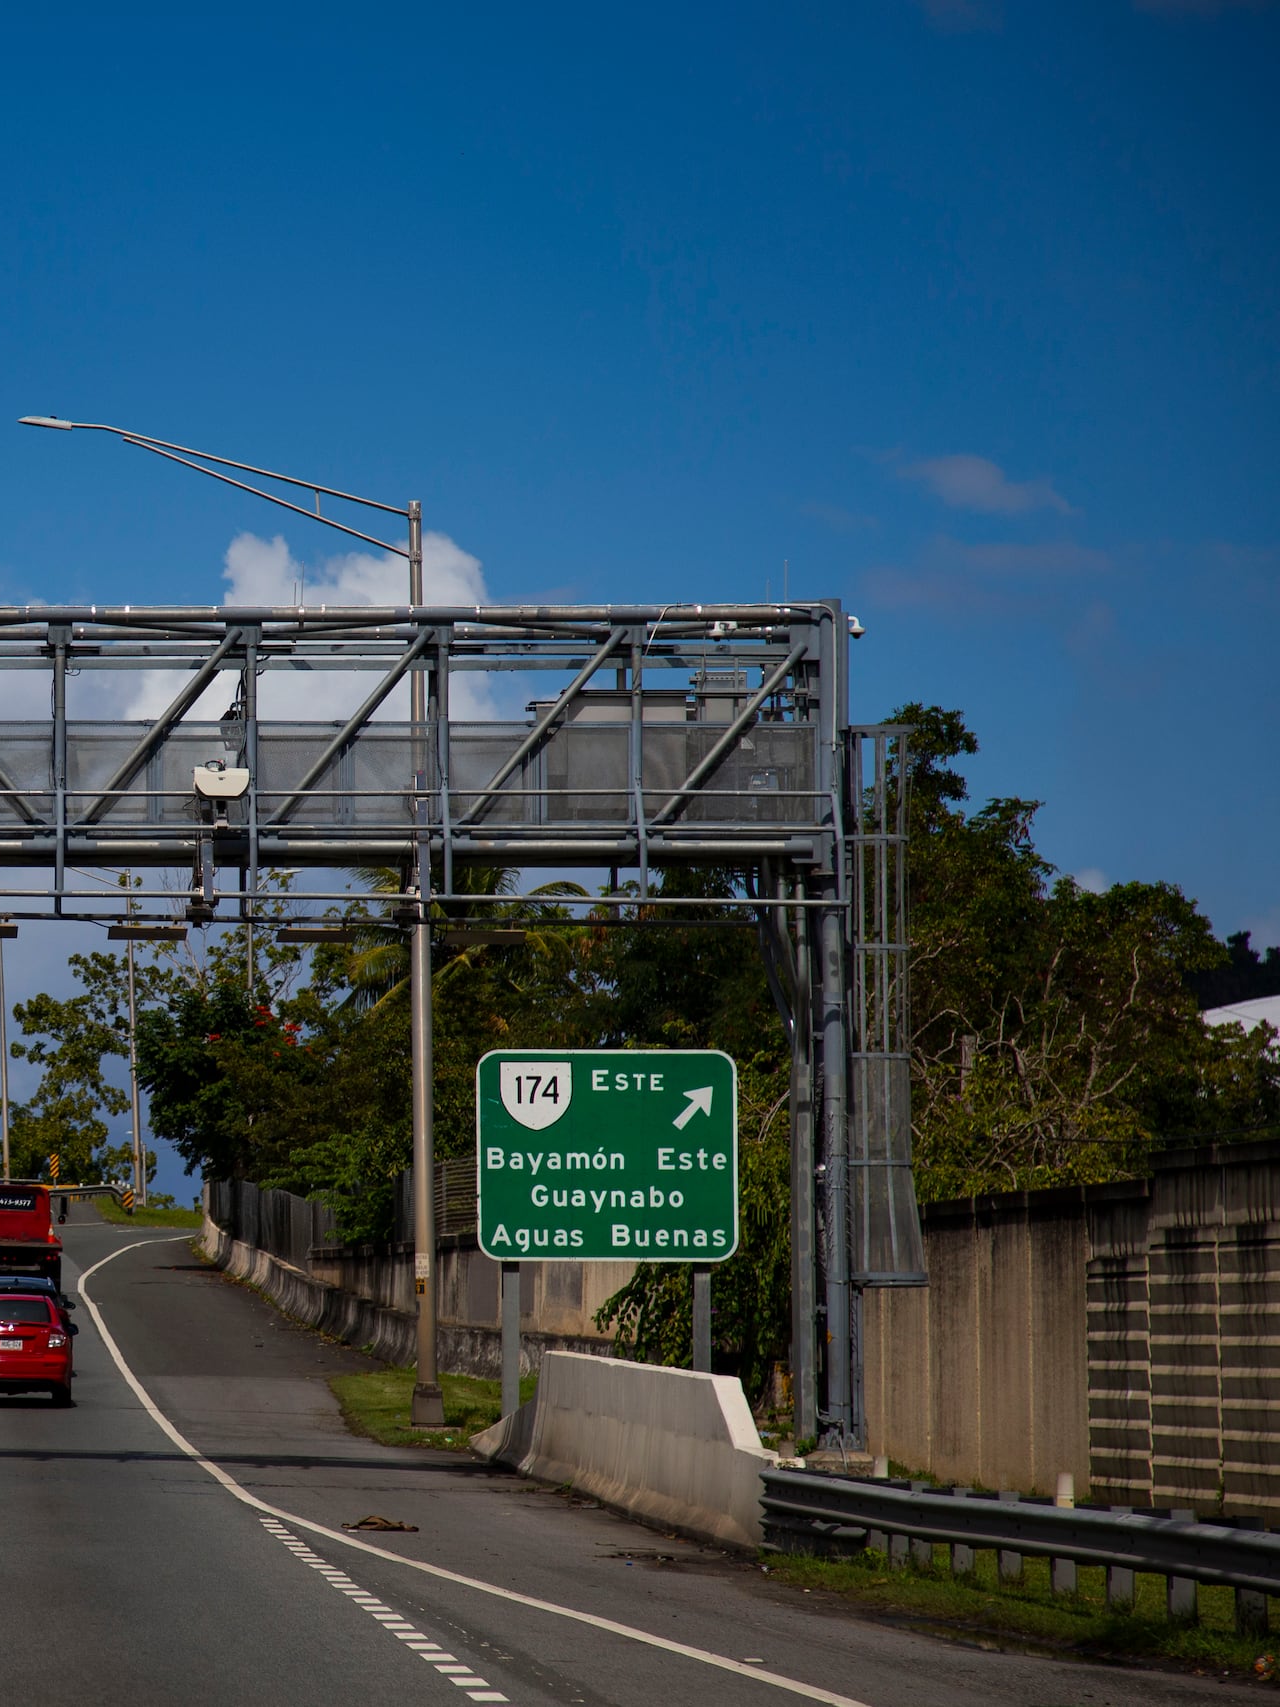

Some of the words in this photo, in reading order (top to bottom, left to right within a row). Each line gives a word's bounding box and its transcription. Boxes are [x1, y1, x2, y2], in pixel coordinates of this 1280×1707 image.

[515, 1076, 560, 1105] 174
[591, 1069, 664, 1091] ESTE
[486, 1146, 625, 1175] Bayamón
[657, 1147, 727, 1171] Este
[531, 1185, 684, 1213] Guaynabo
[491, 1224, 584, 1253] Aguas
[611, 1224, 726, 1247] Buenas
